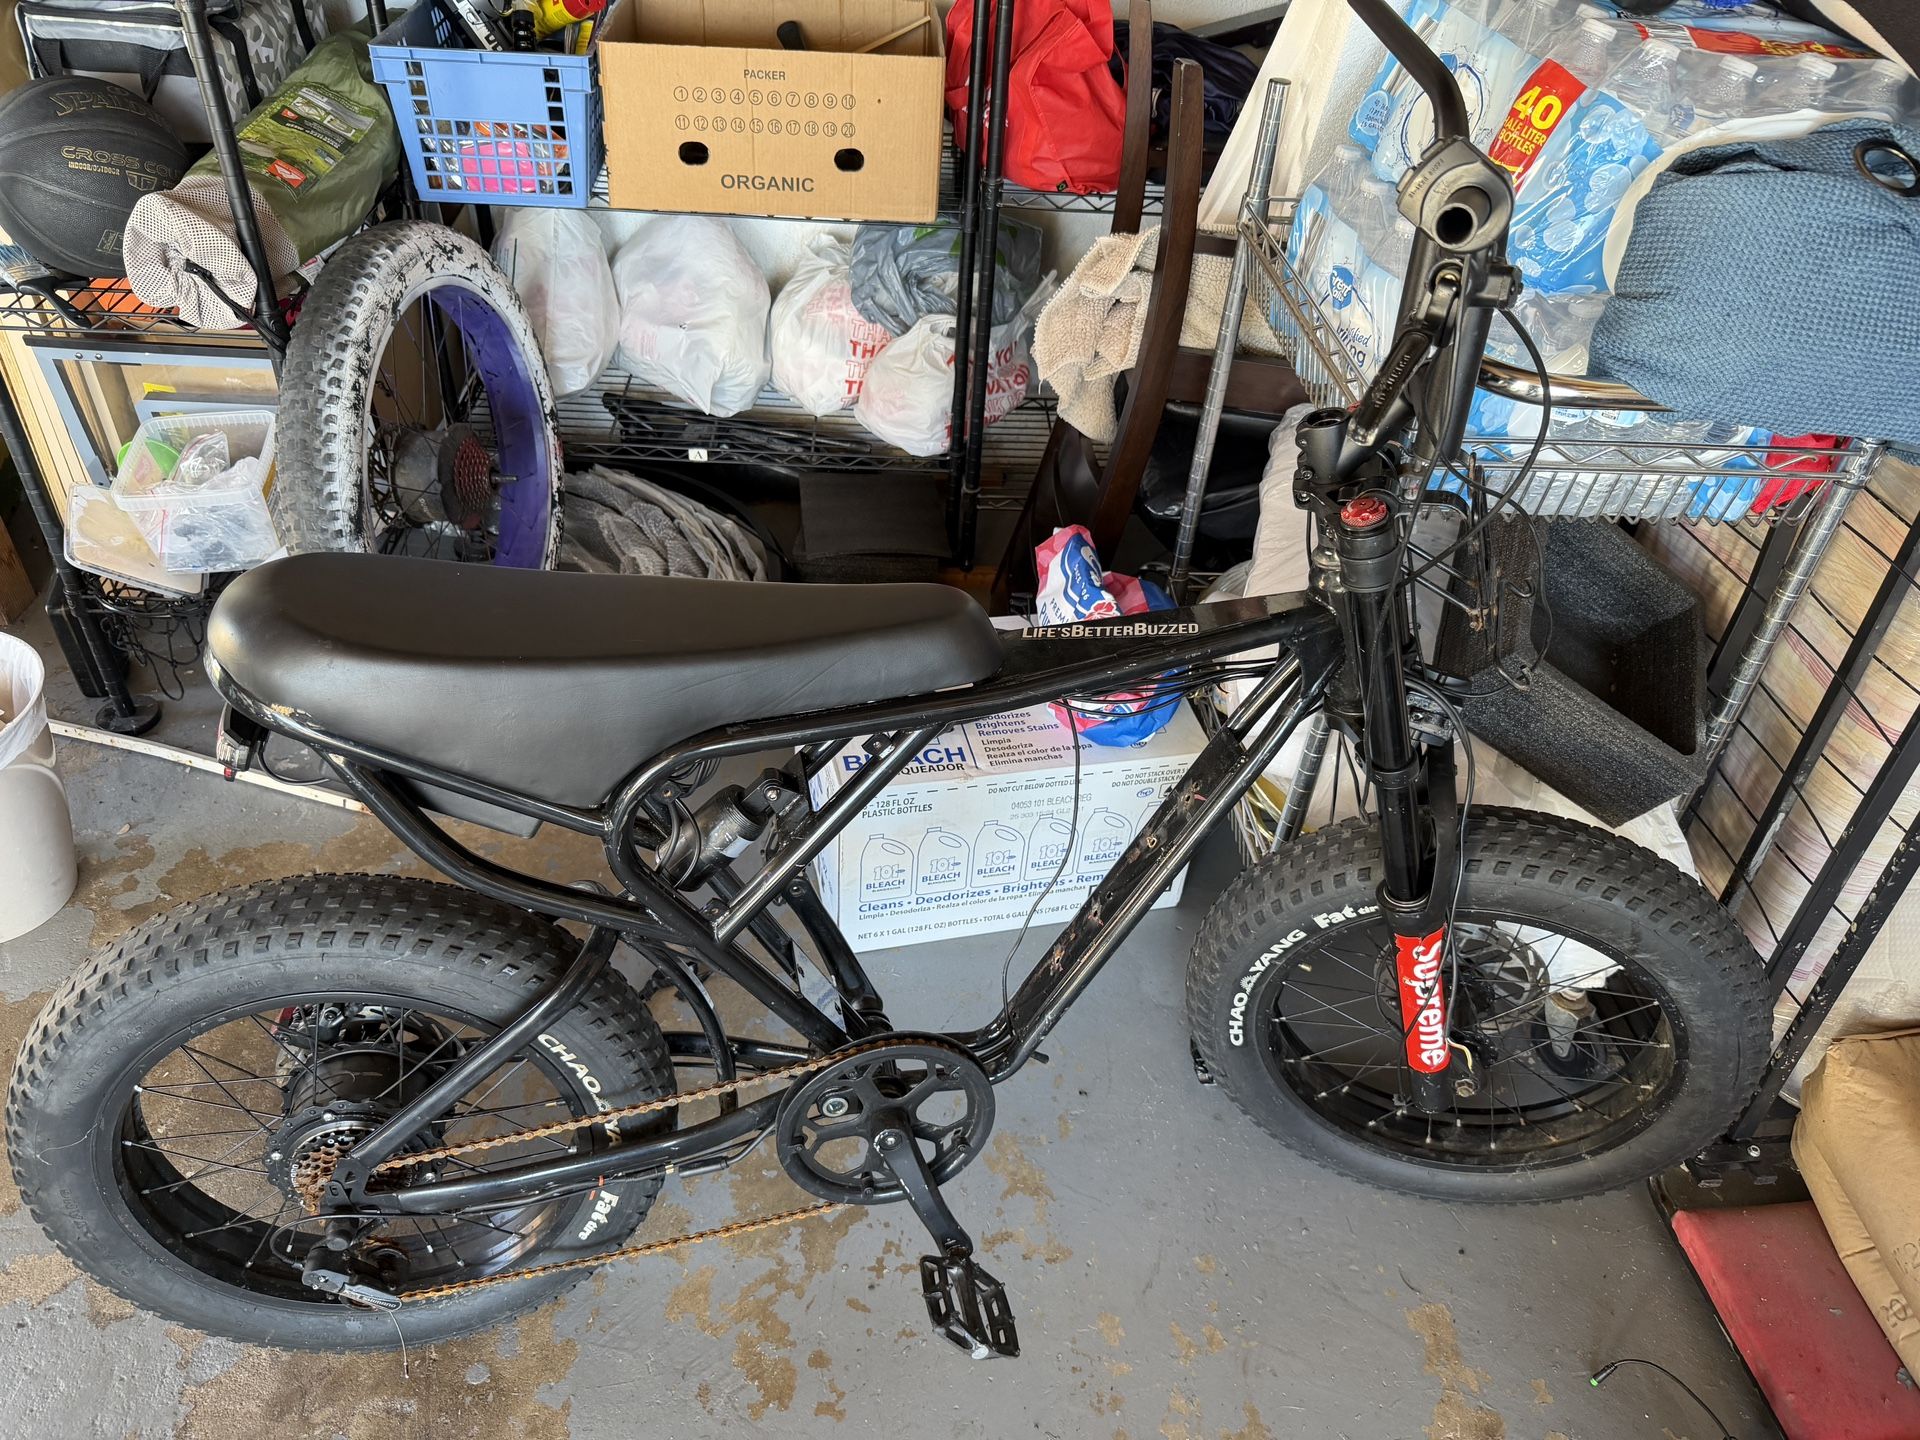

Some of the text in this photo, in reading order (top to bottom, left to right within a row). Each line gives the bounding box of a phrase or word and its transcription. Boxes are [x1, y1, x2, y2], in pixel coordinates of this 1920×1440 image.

[744, 70, 786, 80] PACKER
[1514, 86, 1562, 130] 40
[1499, 129, 1535, 155] BOTTLES
[1521, 125, 1547, 146] LITER
[61, 146, 139, 169] CROSS
[721, 174, 814, 192] ORGANIC
[694, 450, 703, 460] A
[978, 711, 1031, 722] eodorizes
[975, 720, 1026, 730] Brightens
[978, 724, 1059, 737] Removes Stains
[981, 738, 1012, 746] Limpia
[984, 742, 1033, 753] Desodoriza
[987, 752, 1015, 760] Realza
[990, 754, 1063, 767] Elimina manchas
[897, 763, 965, 776] QUEADOR
[1148, 770, 1164, 778] STACK
[1046, 780, 1069, 788] DOTTED
[1158, 775, 1175, 783] STACK
[876, 800, 890, 809] 128
[903, 798, 915, 806] OZ
[1011, 801, 1032, 810] 04053
[1034, 800, 1044, 808] 101
[1047, 796, 1076, 805] BLEACH
[862, 804, 933, 819] PLASTIC BOTTLES
[1084, 851, 1121, 862] BLEACH
[930, 856, 956, 874] 101
[977, 864, 1015, 876] BLEACH
[1031, 858, 1067, 869] BLEAC
[874, 864, 899, 880] 101
[922, 872, 960, 882] BLEACH
[866, 879, 905, 890] BLEACH
[858, 900, 904, 913] Cleans
[916, 889, 991, 906] Deodorizes
[1002, 878, 1064, 894] Brightens
[858, 912, 884, 920] Limpia
[890, 906, 931, 916] Desodoriza
[936, 902, 960, 910] Realza
[969, 898, 987, 906] color
[999, 894, 1005, 902] la
[1006, 893, 1023, 902] ropa
[1056, 885, 1086, 894] manchas
[908, 925, 923, 934] (128
[934, 922, 947, 930] OZ)
[948, 918, 979, 928] BOTTLES
[983, 914, 1005, 922] TOTAL
[1012, 909, 1044, 918] GALLNS
[1313, 904, 1380, 928] Fat tir
[1412, 939, 1446, 1066] Supreme
[578, 1190, 620, 1241] Fat tire
